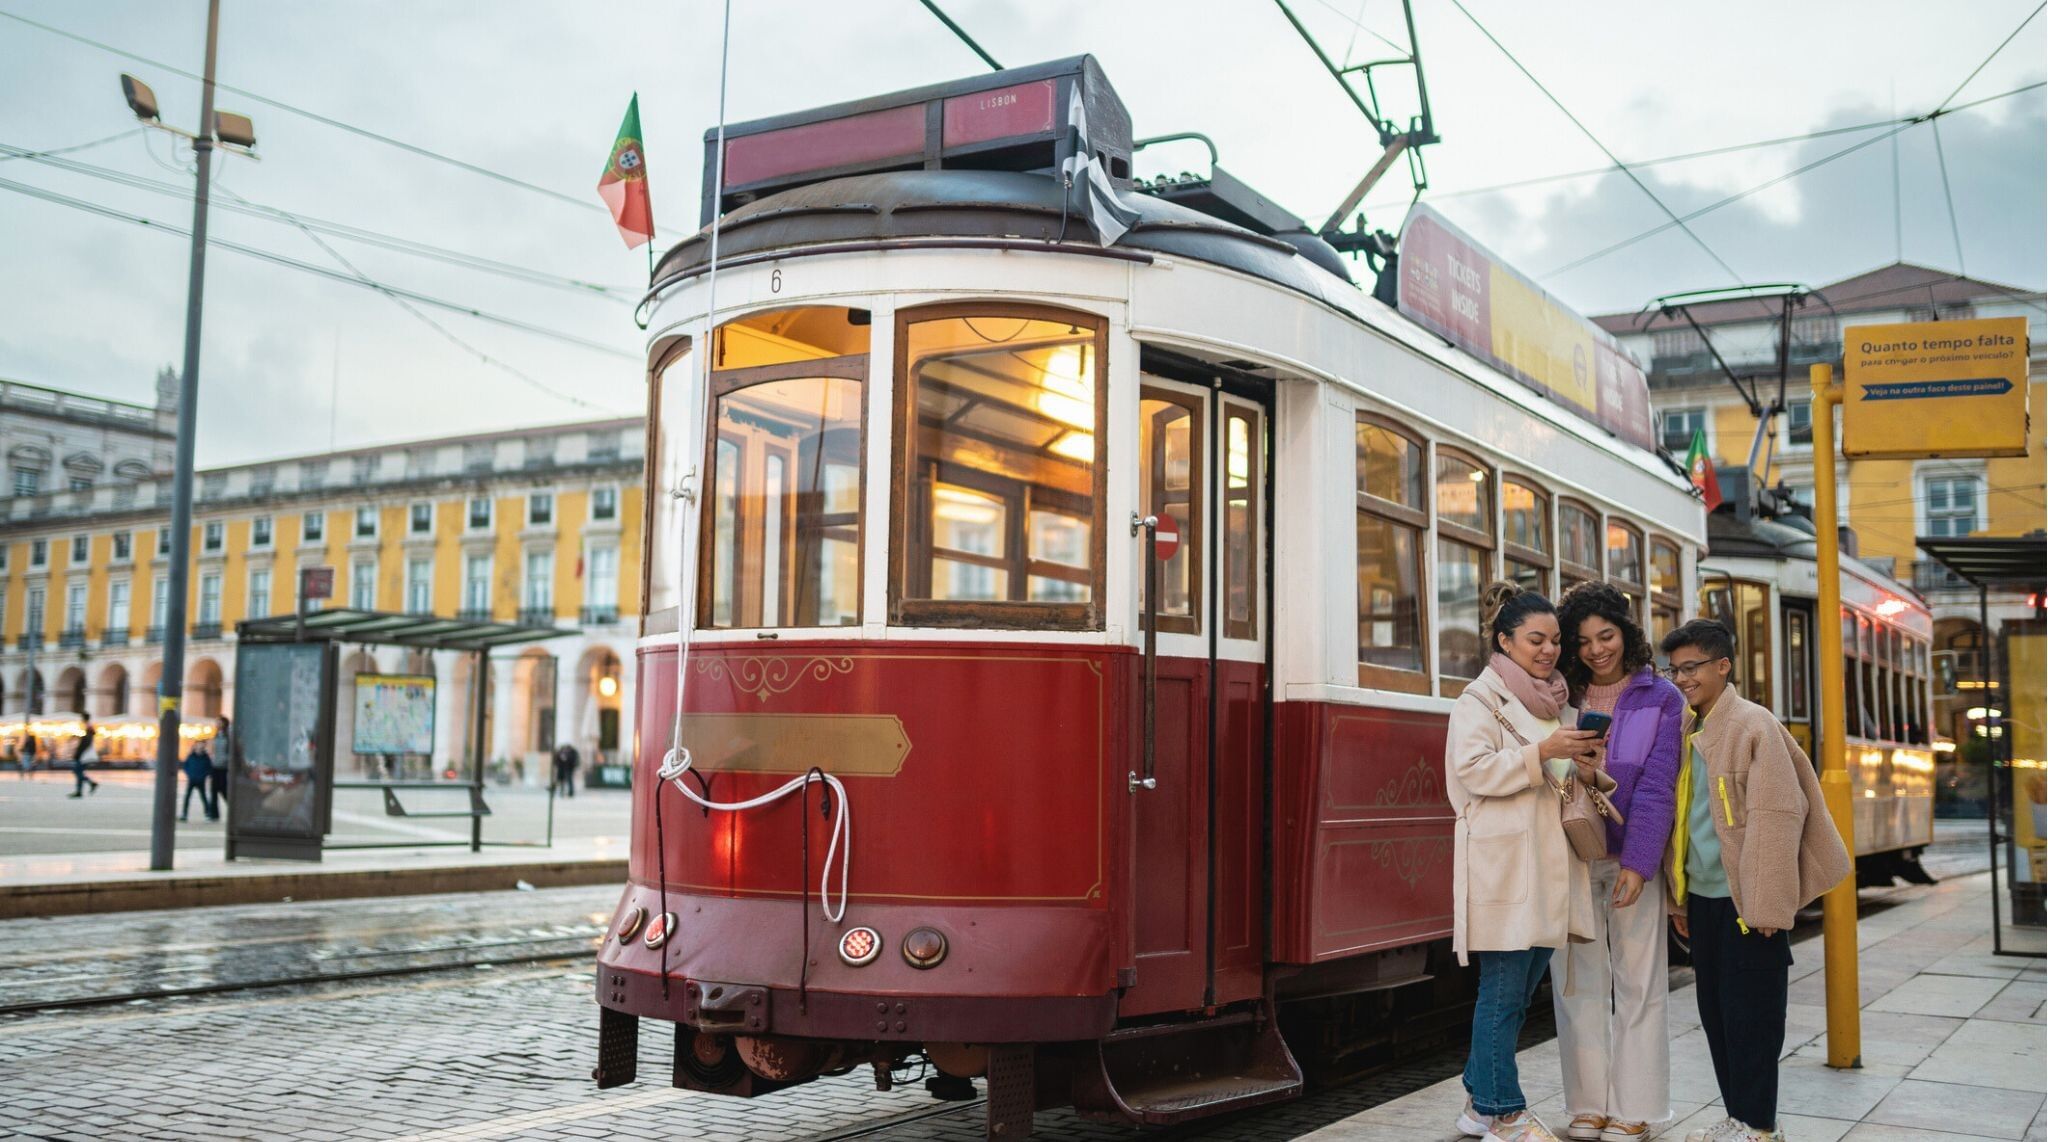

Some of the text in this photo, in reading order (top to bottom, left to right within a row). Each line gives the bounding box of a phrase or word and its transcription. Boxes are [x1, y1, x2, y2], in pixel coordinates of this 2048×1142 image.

[980, 94, 1017, 110] LISBON
[771, 269, 782, 293] 6
[1447, 254, 1481, 294] TICKETS
[1452, 288, 1479, 324] INSIDE
[1861, 334, 2015, 354] Quanto tempo falta
[1861, 359, 1883, 368] para
[1920, 356, 1927, 364] o
[1870, 387, 1888, 397] Veja
[1902, 386, 1926, 394] outra
[1927, 384, 1946, 393] face
[1947, 383, 1972, 392] deste
